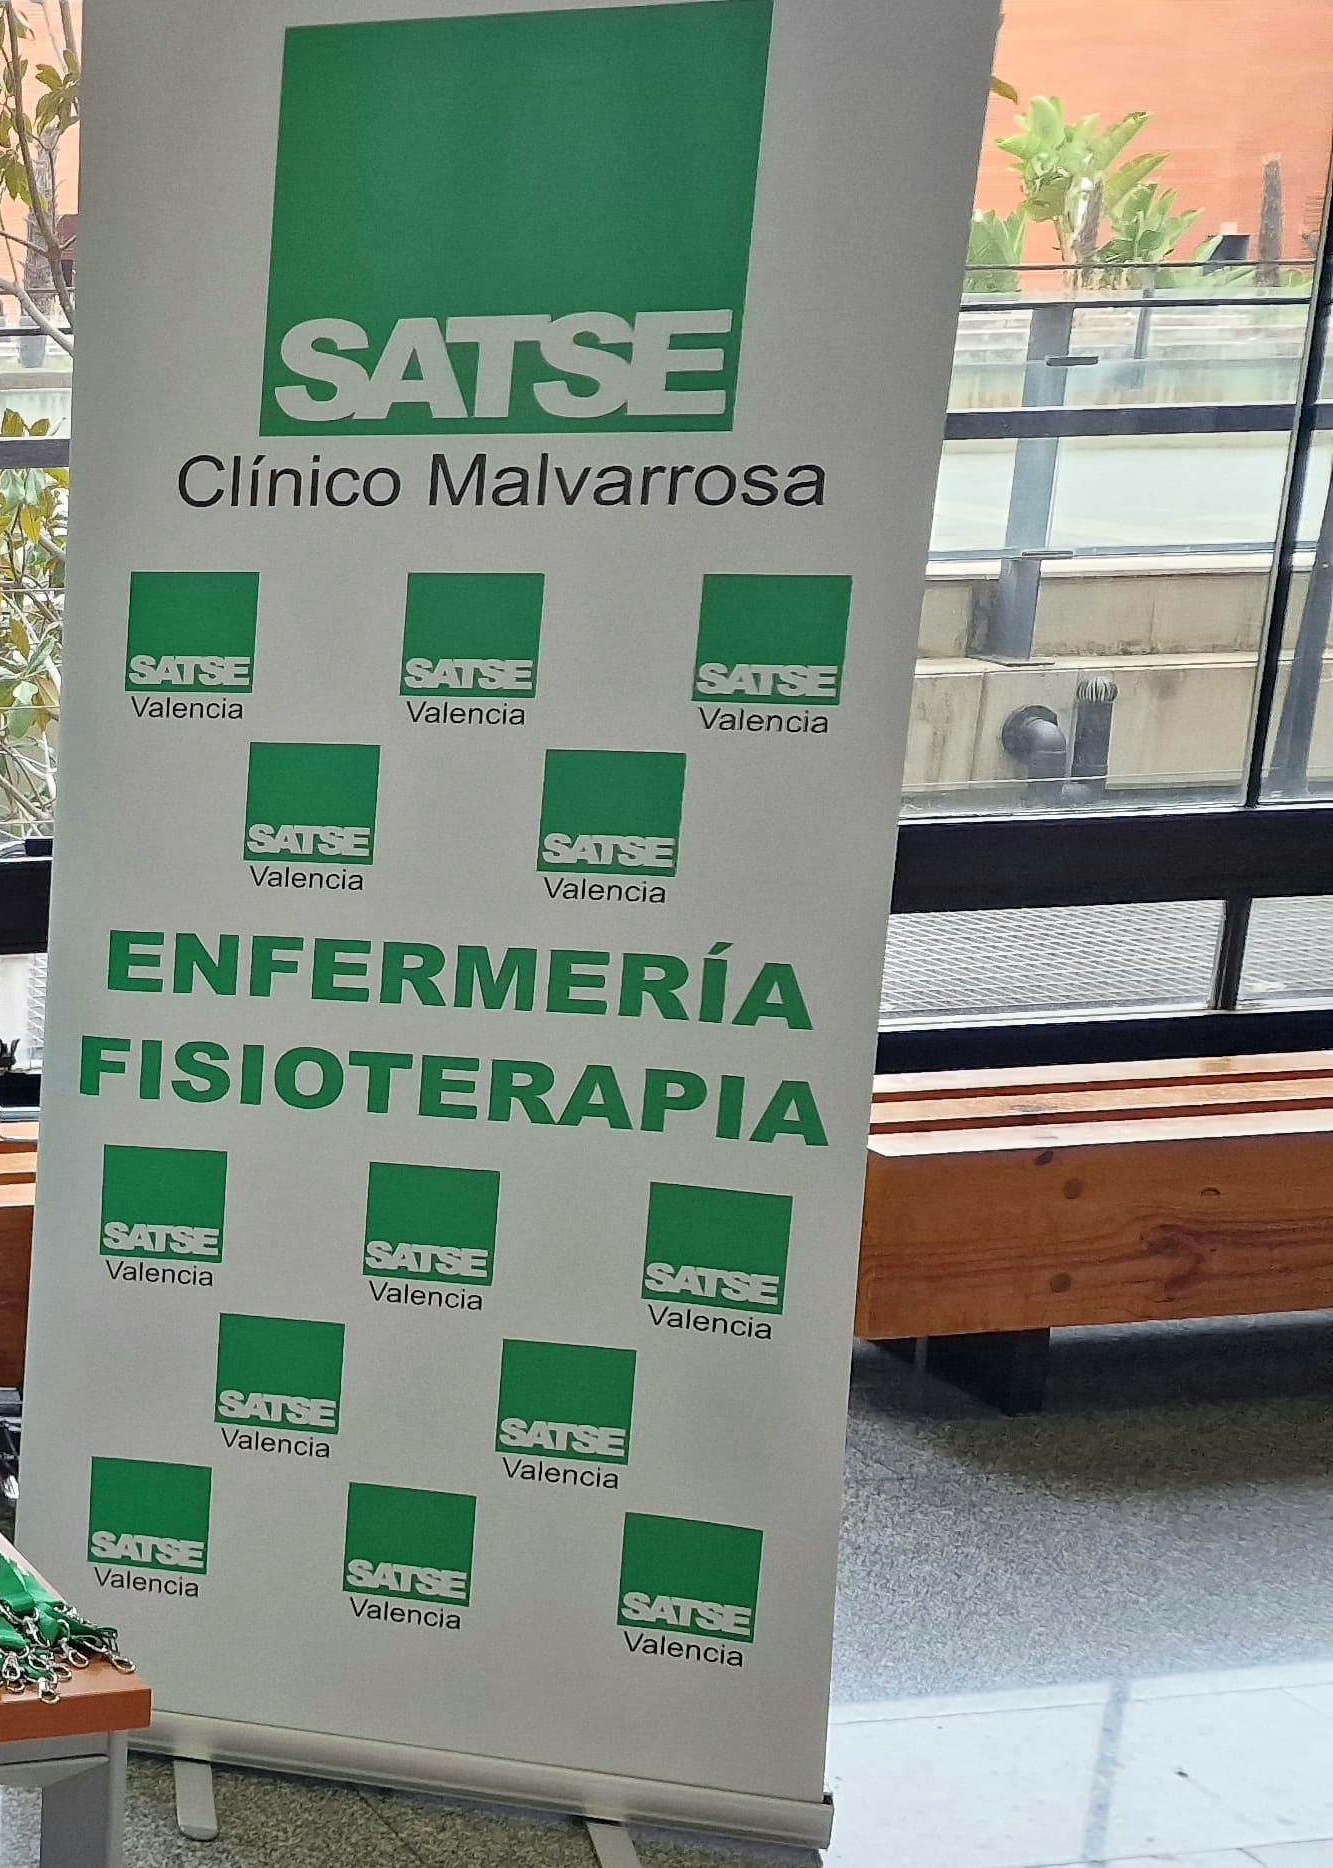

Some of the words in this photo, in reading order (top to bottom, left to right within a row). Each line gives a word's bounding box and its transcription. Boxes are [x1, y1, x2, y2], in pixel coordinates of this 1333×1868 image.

[275, 308, 732, 422] SATSE
[178, 453, 403, 509] Clínico
[429, 453, 827, 509] Malvarrosa
[129, 655, 251, 686] SATSE
[696, 662, 838, 698] SATSE
[131, 695, 244, 720] Valencia
[698, 706, 829, 734] Valencia
[247, 823, 371, 857] SATSE
[249, 865, 364, 891] Valencia
[107, 928, 814, 1031] ENFERMERÍA
[78, 1033, 829, 1147] FISIOTERAPIA
[103, 1221, 220, 1256] SATSE
[106, 1260, 215, 1287] Valencia
[644, 1261, 780, 1306] SATSE
[648, 1304, 773, 1341] Valencia
[91, 1530, 205, 1569] SATSE
[94, 1566, 200, 1598] Valencia
[621, 1591, 752, 1637] SATSE
[624, 1631, 745, 1668] Valencia
